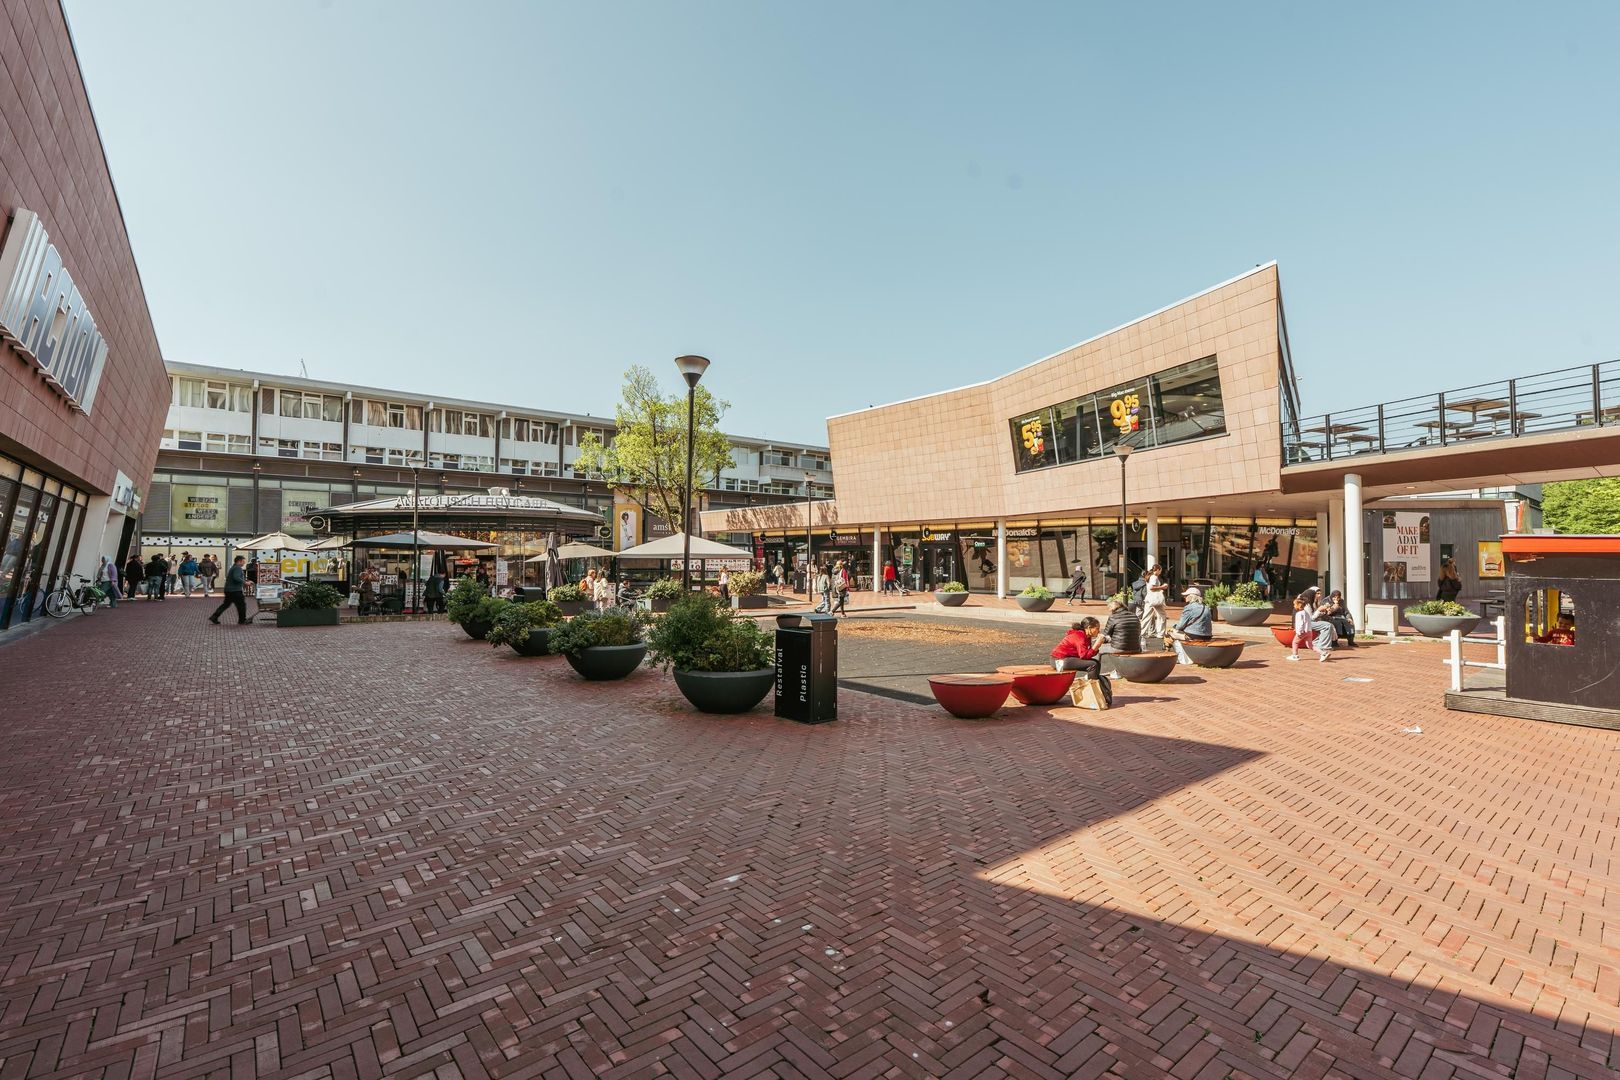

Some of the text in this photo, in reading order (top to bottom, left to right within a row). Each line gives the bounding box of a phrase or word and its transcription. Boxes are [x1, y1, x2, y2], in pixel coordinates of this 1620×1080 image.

[19, 243, 104, 406] ACTION
[991, 528, 1038, 537] MDonald's
[1259, 526, 1301, 536] McDonald's
[1396, 526, 1419, 535] MAKE
[1397, 536, 1419, 545] A DAY
[1396, 545, 1419, 555] OF IT
[799, 664, 807, 702] Plastic
